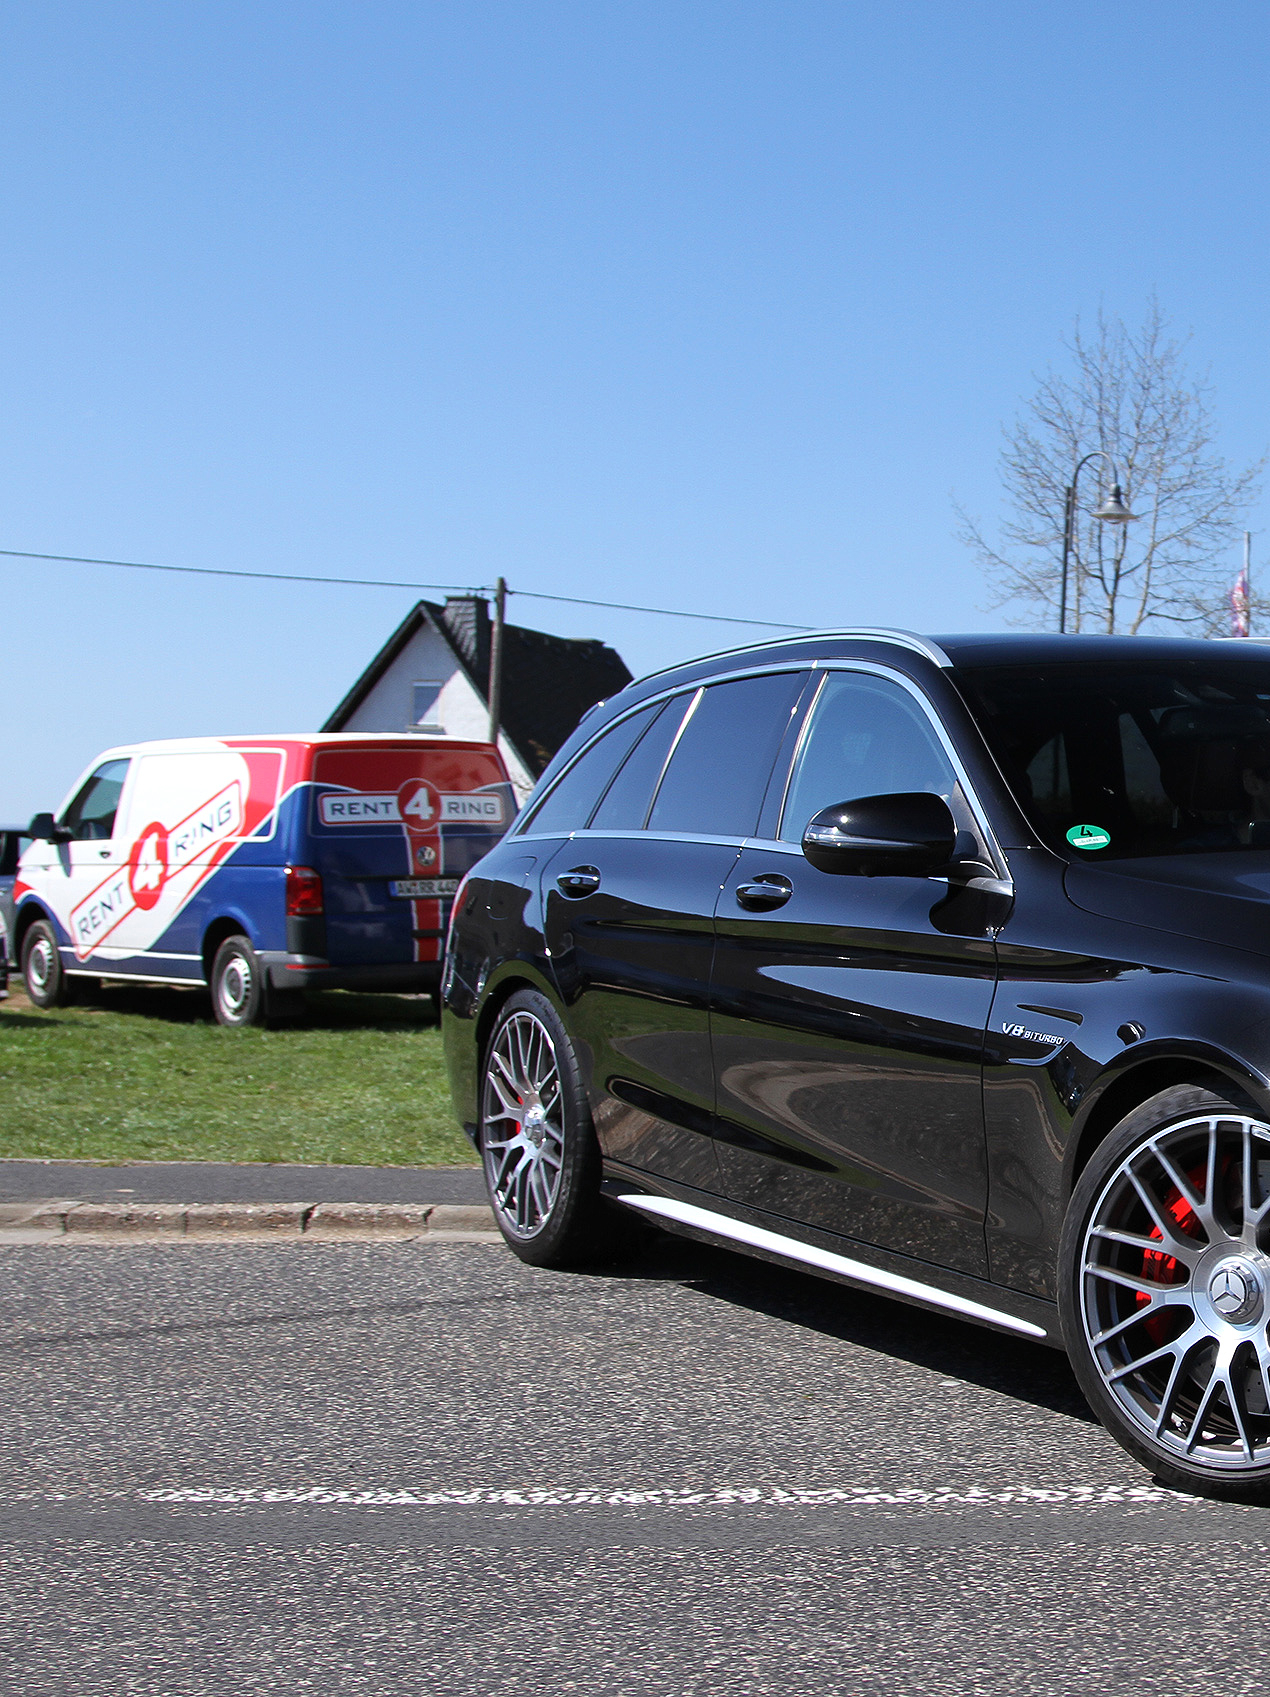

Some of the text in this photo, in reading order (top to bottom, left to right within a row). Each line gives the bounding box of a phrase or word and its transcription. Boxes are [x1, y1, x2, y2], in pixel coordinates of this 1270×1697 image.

[331, 787, 497, 820] RENT 4 RING
[1080, 825, 1093, 837] 4
[77, 800, 232, 941] RENT 4 RING
[1002, 1022, 1065, 1046] V8 BITURBO
